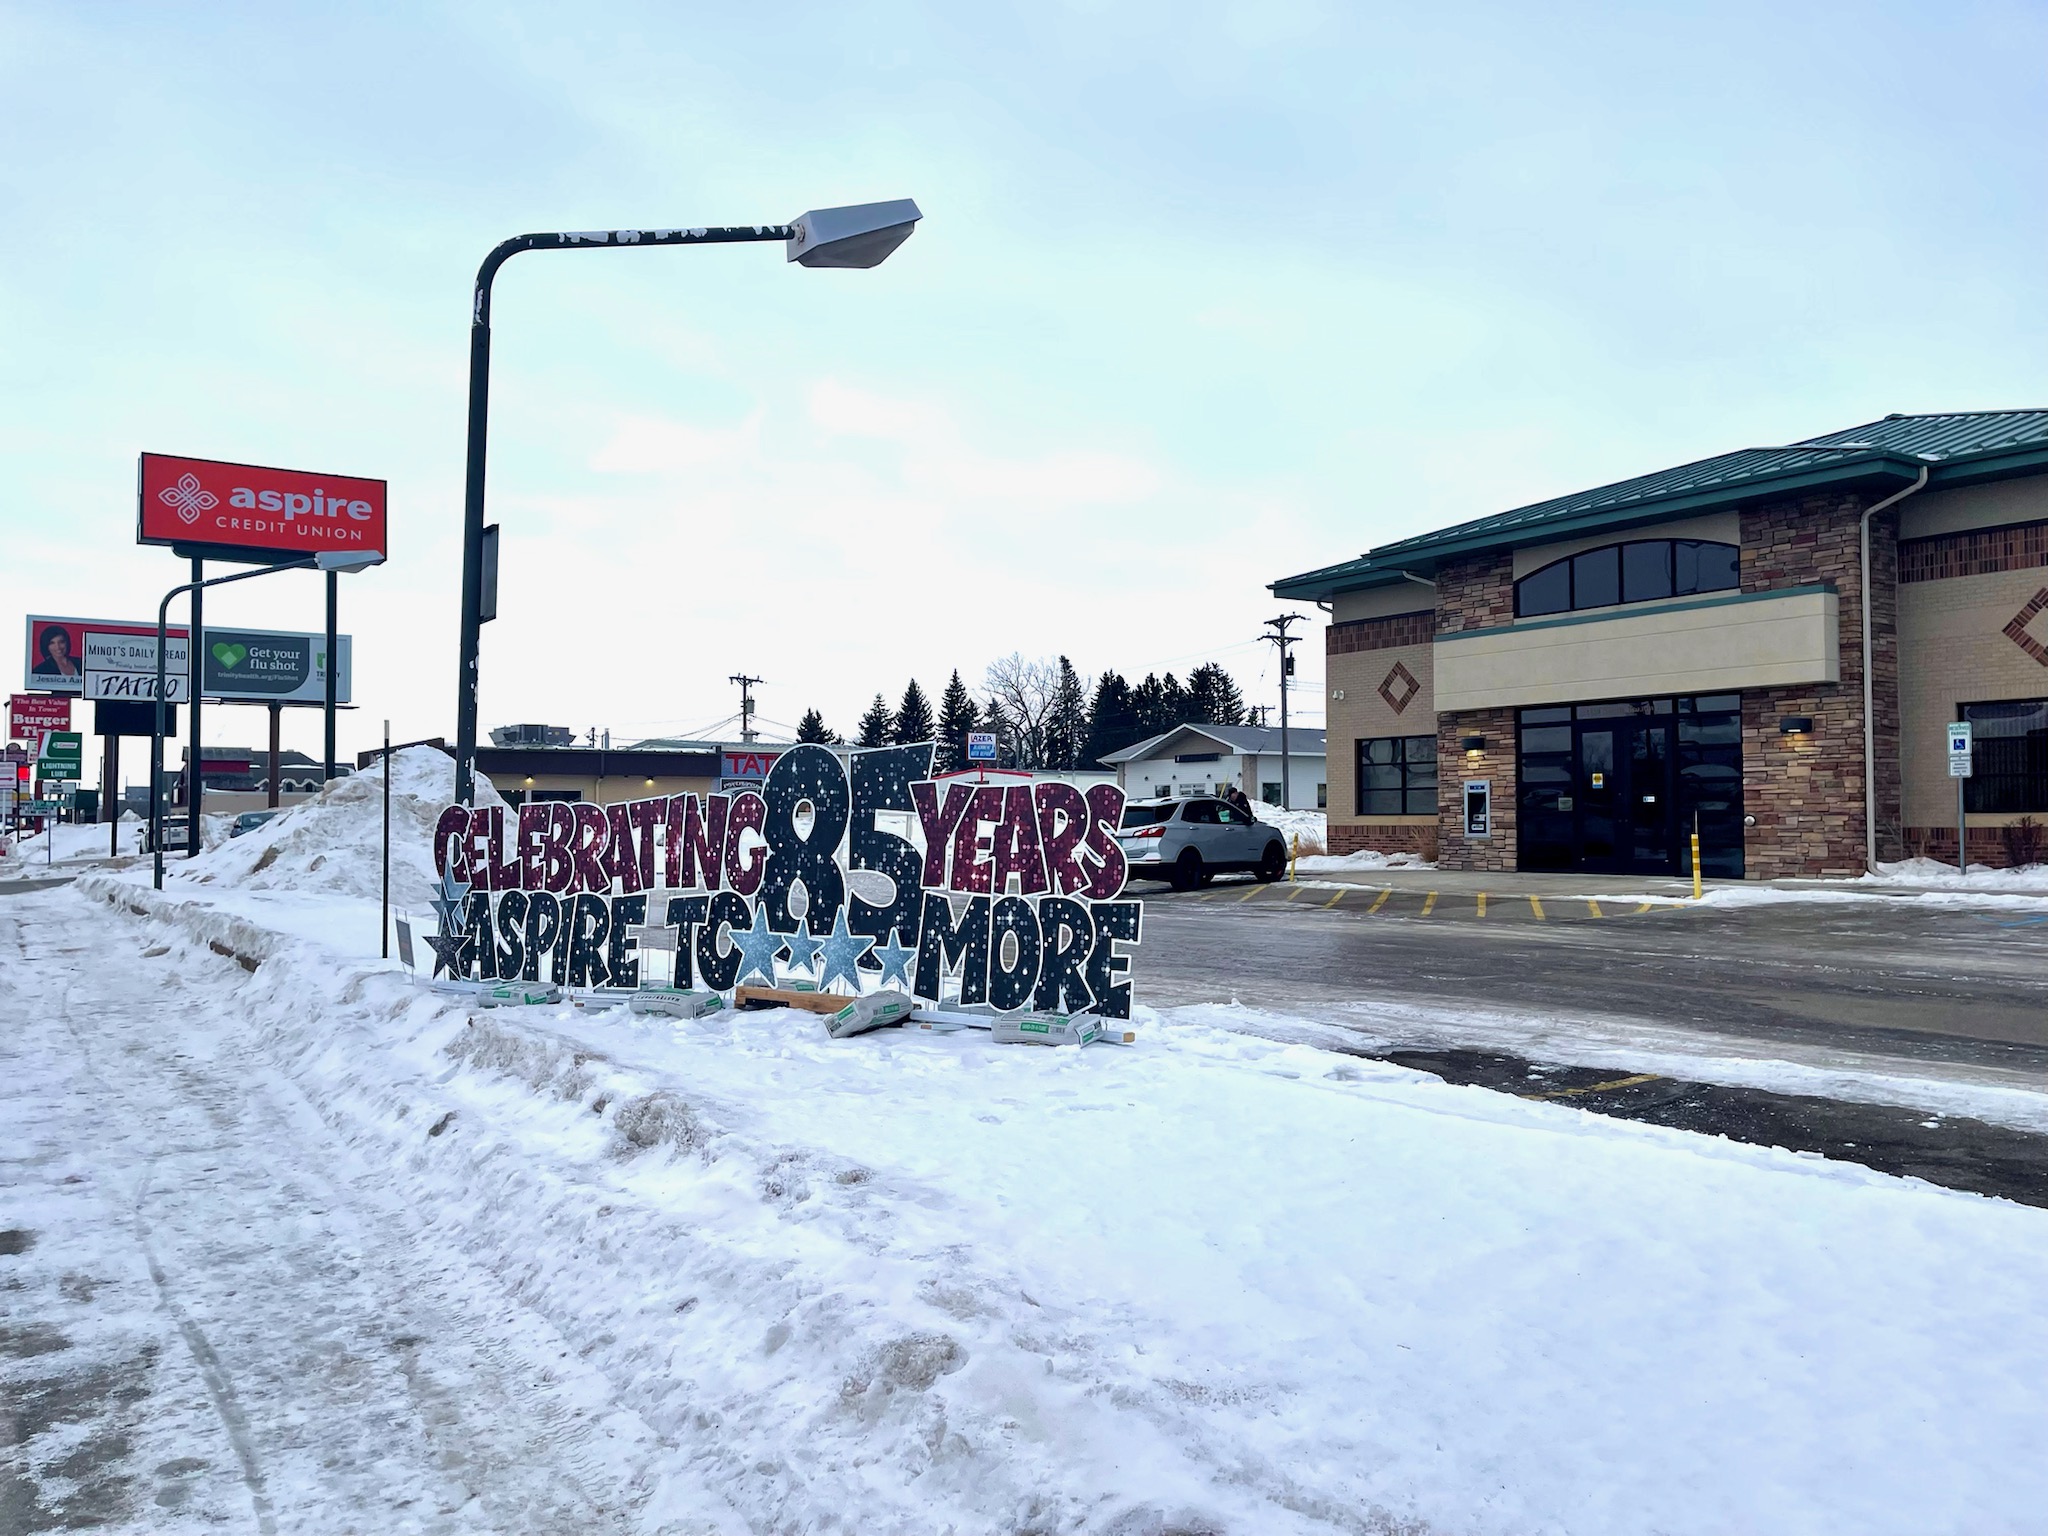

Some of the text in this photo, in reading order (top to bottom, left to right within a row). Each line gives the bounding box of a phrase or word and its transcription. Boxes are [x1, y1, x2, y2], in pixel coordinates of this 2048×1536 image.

[229, 487, 373, 521] aspire
[215, 516, 362, 541] CREDIT UNION
[88, 644, 187, 661] MINOT'S DAILY READ
[249, 647, 301, 661] Get your
[249, 659, 299, 672] flu shot.
[36, 675, 67, 684] Jessica
[13, 713, 69, 727] Burger
[970, 735, 993, 743] LAZER
[41, 762, 77, 770] LIGHTNING
[50, 770, 67, 778] LUBE
[434, 743, 1128, 975] CELEBRATING 85 YEARS
[457, 890, 1143, 1021] ASPIRE TO MORE
